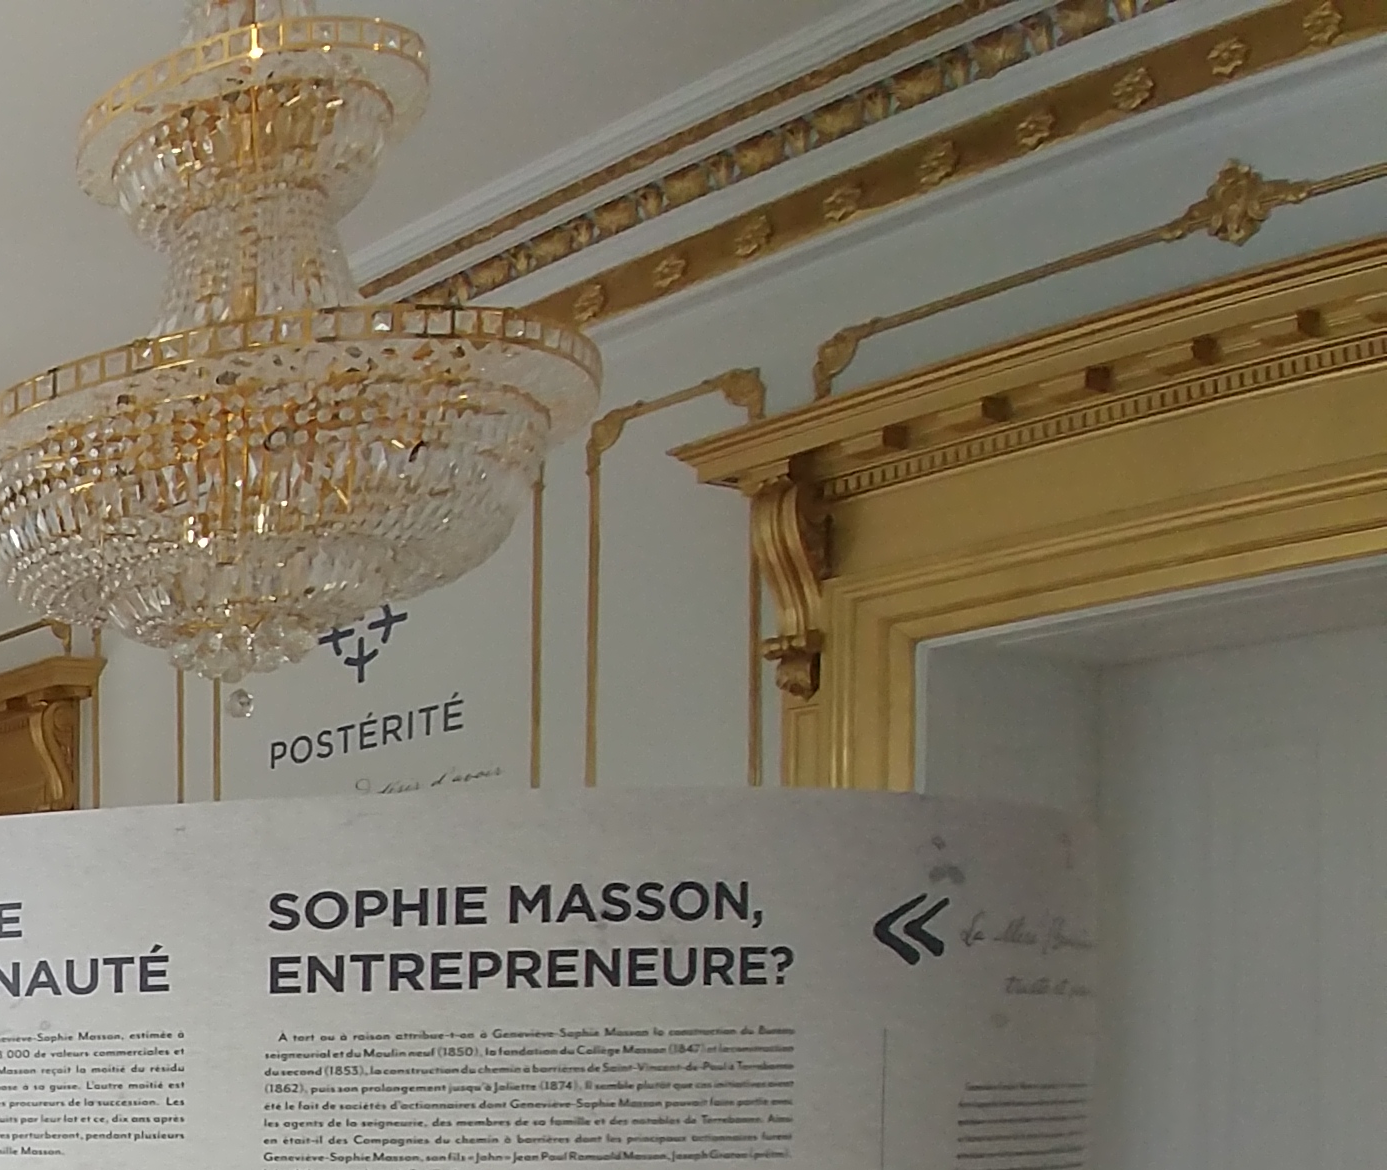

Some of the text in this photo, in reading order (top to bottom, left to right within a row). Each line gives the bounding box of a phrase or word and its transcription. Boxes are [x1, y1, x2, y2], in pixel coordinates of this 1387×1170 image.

[269, 691, 466, 770] POSTÉRITÉ
[267, 880, 762, 931] SOPHIE MASSON,
[268, 945, 794, 994] ENTREPRENEURE?
[78, 1032, 125, 1040] Masson,
[129, 1031, 173, 1039] estimée
[293, 1034, 315, 1042] tort
[353, 1032, 391, 1040] raison
[7, 1050, 31, 1058] 000
[50, 1049, 90, 1057] valeurs
[93, 1047, 170, 1057] commerciales
[265, 1049, 331, 1061] seigneurial
[363, 1048, 407, 1058] Moulin
[41, 1066, 72, 1076] reçoit
[91, 1065, 126, 1073] moitié
[150, 1063, 185, 1072] résidu
[281, 1067, 323, 1076] second
[86, 1081, 124, 1090] L'autre
[128, 1081, 164, 1089] moitié
[311, 1087, 336, 1095] puis
[361, 1083, 447, 1095] prolongement
[9, 1101, 66, 1109] procureurs
[166, 1097, 186, 1106] Les
[299, 1101, 319, 1110] fait
[390, 1100, 477, 1110] d'actionnaires
[41, 1114, 62, 1123] leur
[63, 1114, 78, 1122] lot
[154, 1117, 186, 1125] après
[264, 1118, 279, 1127] les
[283, 1121, 324, 1130] agents
[432, 1117, 452, 1127] des
[85, 1130, 133, 1141] pendant
[134, 1130, 186, 1141] plusieurs
[328, 1136, 348, 1144] des
[353, 1135, 430, 1147] Compagnies
[455, 1135, 500, 1144] chemin
[373, 1152, 424, 1162] Masson,
[512, 1152, 540, 1164] Jean
[541, 1152, 568, 1161] Paul
